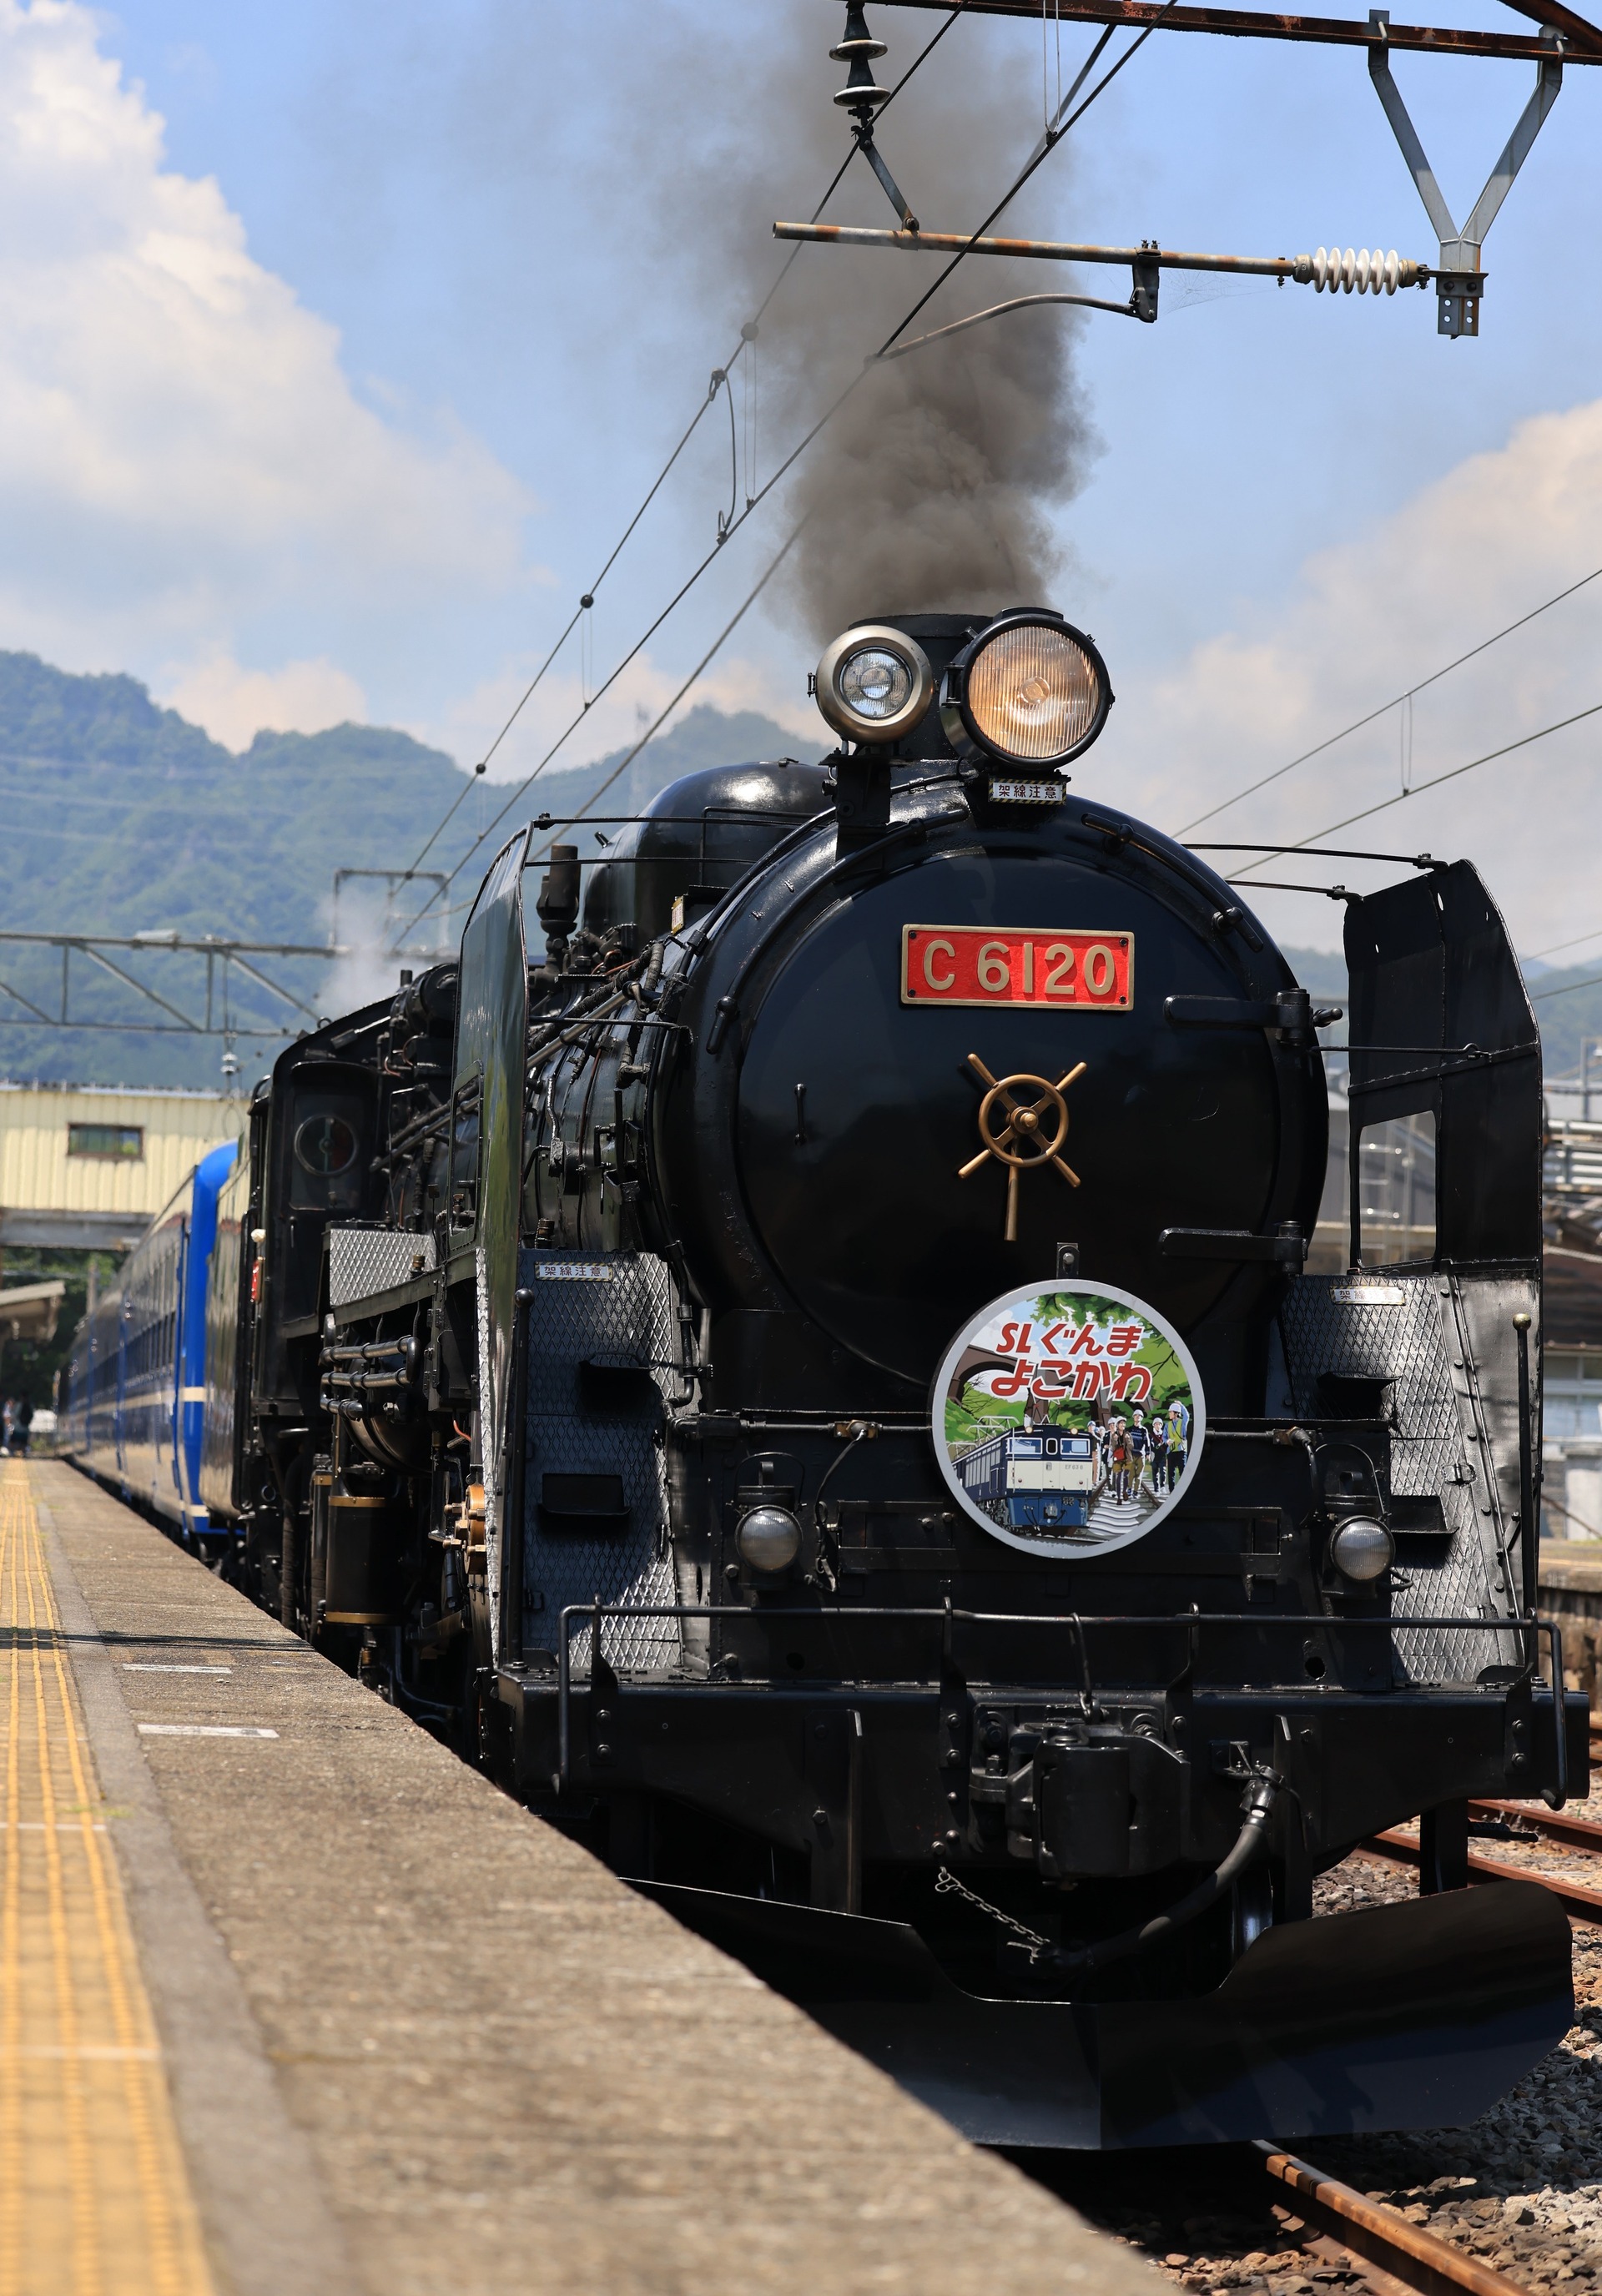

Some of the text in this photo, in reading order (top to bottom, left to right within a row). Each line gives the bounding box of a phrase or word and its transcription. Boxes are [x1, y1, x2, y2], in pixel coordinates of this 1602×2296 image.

[998, 784, 1056, 798] 架線注意
[544, 1266, 602, 1276] 架線注意
[990, 1358, 1153, 1401] よこかわ
